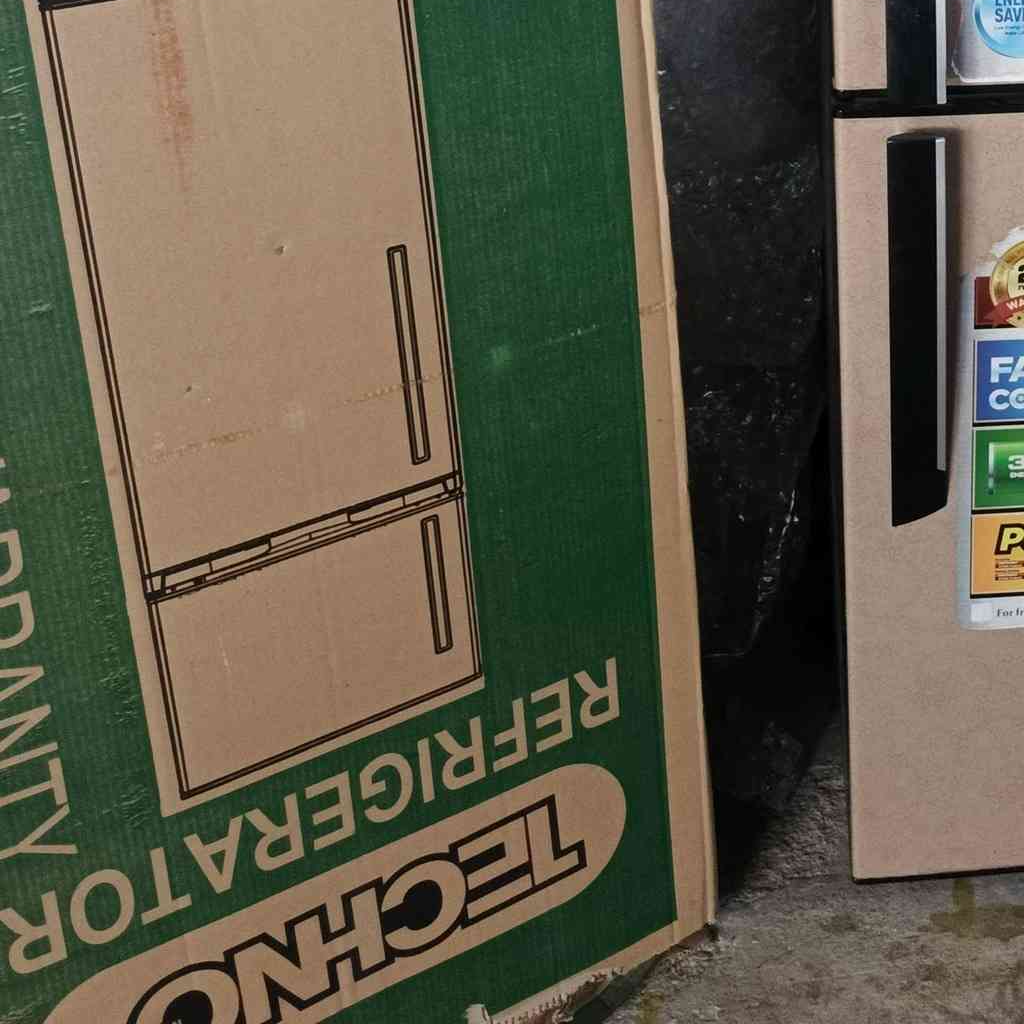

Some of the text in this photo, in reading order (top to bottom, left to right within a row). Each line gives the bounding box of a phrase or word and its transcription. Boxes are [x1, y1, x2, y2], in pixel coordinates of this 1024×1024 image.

[997, 608, 1013, 617] For
[0, 656, 620, 974] REFRIGERATOR
[126, 793, 588, 1024] TECHNO
